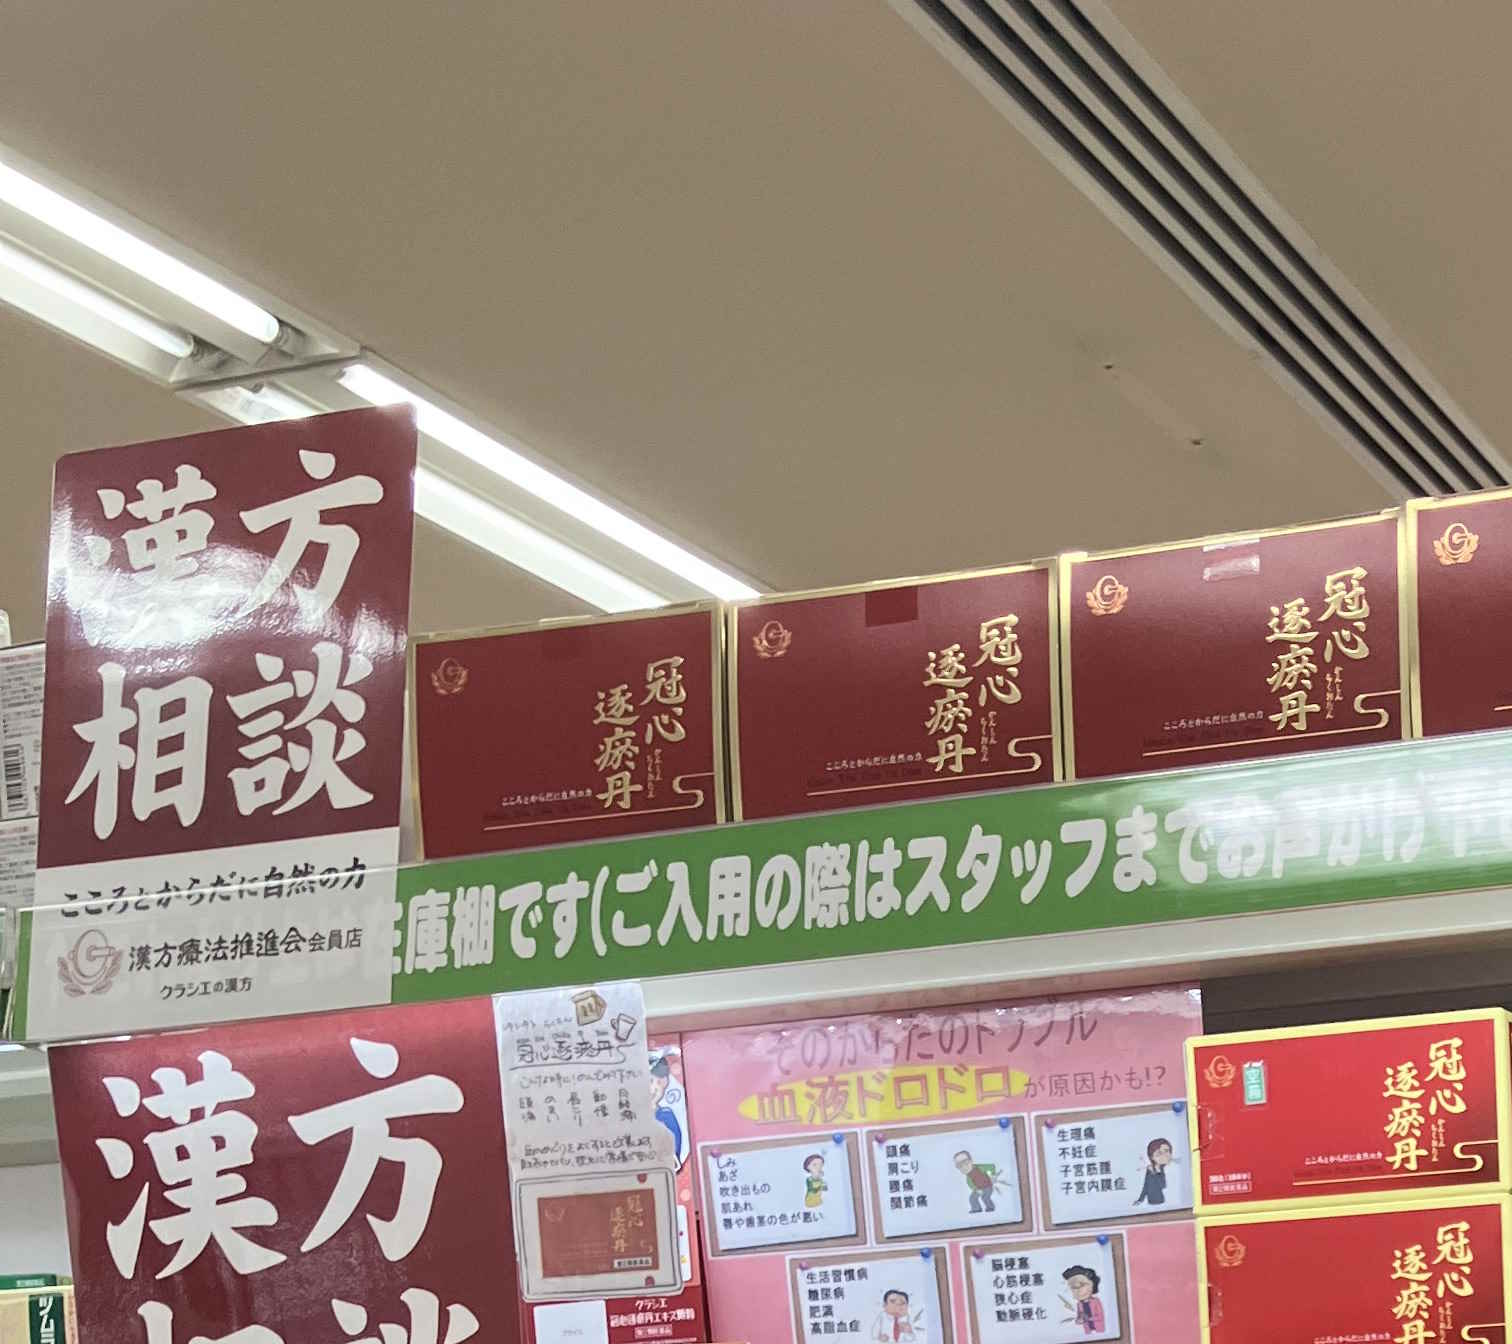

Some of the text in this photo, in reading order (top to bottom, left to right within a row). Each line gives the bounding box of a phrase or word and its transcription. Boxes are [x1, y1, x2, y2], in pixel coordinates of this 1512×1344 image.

[62, 449, 384, 645] 漢方
[64, 641, 375, 839] 相談
[61, 856, 366, 919] こころとからだに自然の力
[159, 978, 252, 1000] クラシエの漢方
[96, 1037, 465, 1281] 漢方
